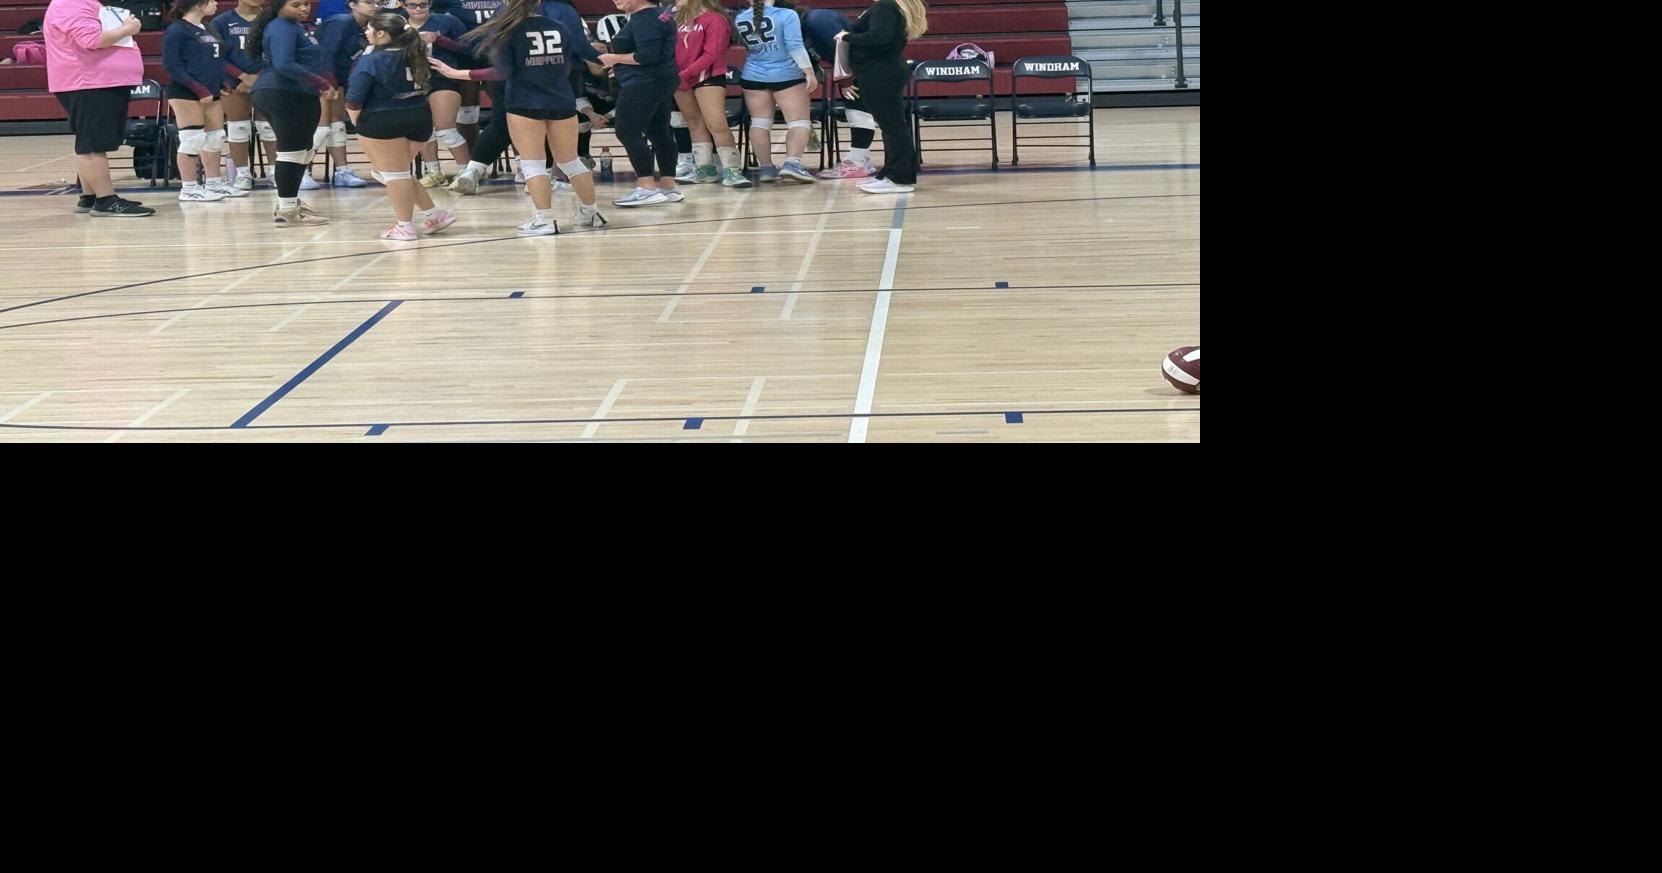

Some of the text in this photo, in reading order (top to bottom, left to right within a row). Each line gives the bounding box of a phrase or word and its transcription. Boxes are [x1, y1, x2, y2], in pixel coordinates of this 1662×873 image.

[736, 16, 776, 46] 22
[212, 43, 220, 58] 3
[525, 30, 563, 56] 32
[925, 66, 980, 76] WINDHAM
[1024, 62, 1080, 72] WINDHAM
